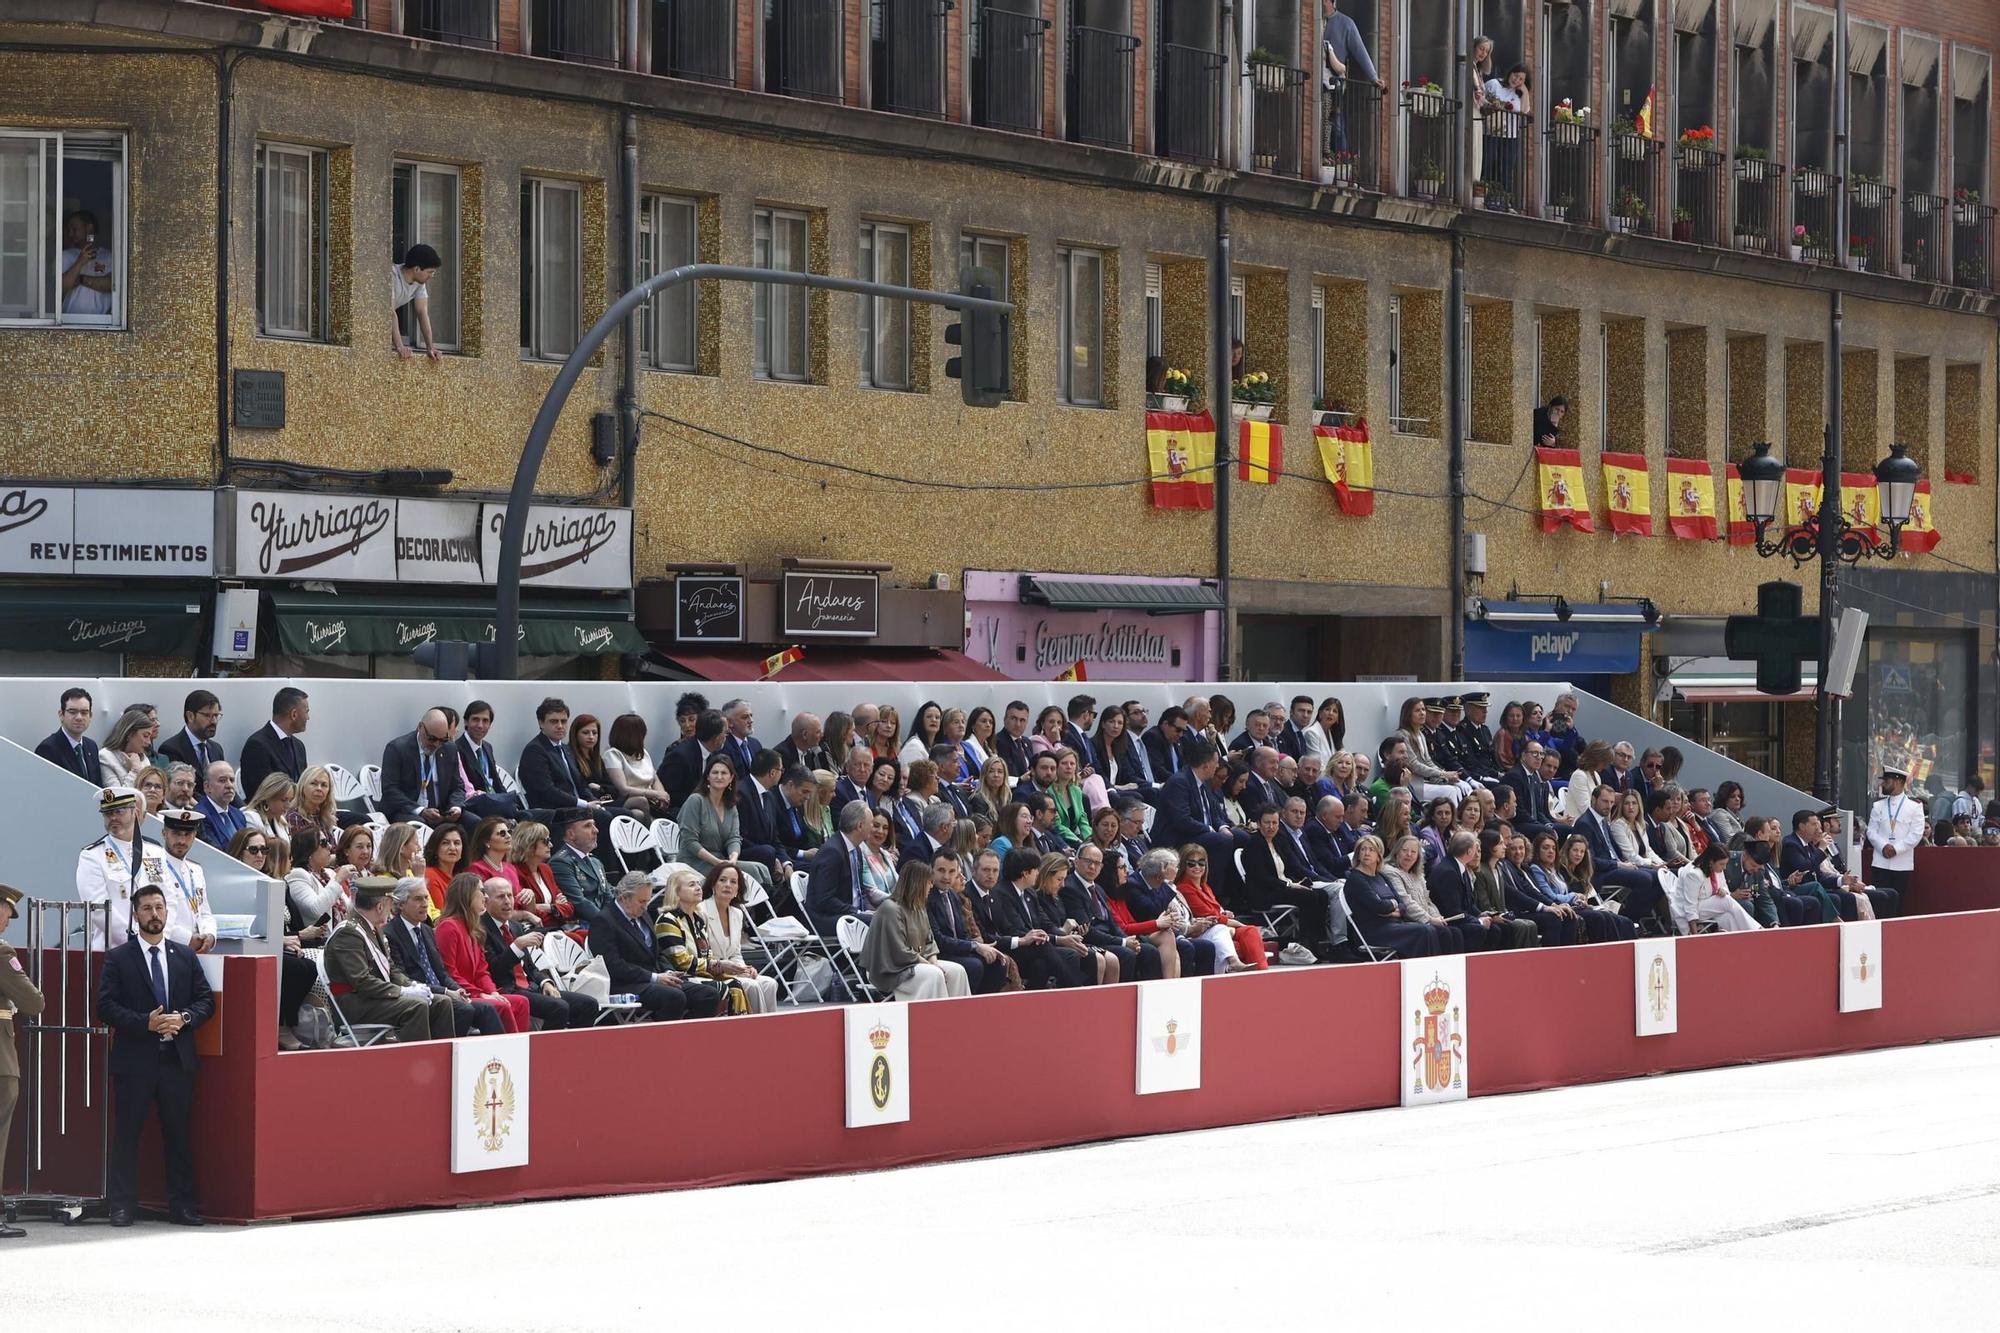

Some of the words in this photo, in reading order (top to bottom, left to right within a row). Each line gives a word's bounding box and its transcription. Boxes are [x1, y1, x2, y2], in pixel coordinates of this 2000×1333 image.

[30, 543, 208, 562] REVESTIMIENTOS
[251, 500, 390, 574] Yturriaga
[797, 578, 865, 616] Andares
[1036, 620, 1097, 671] Gemma
[1099, 622, 1167, 663] Estilistas
[1531, 632, 1573, 662] pelayo
